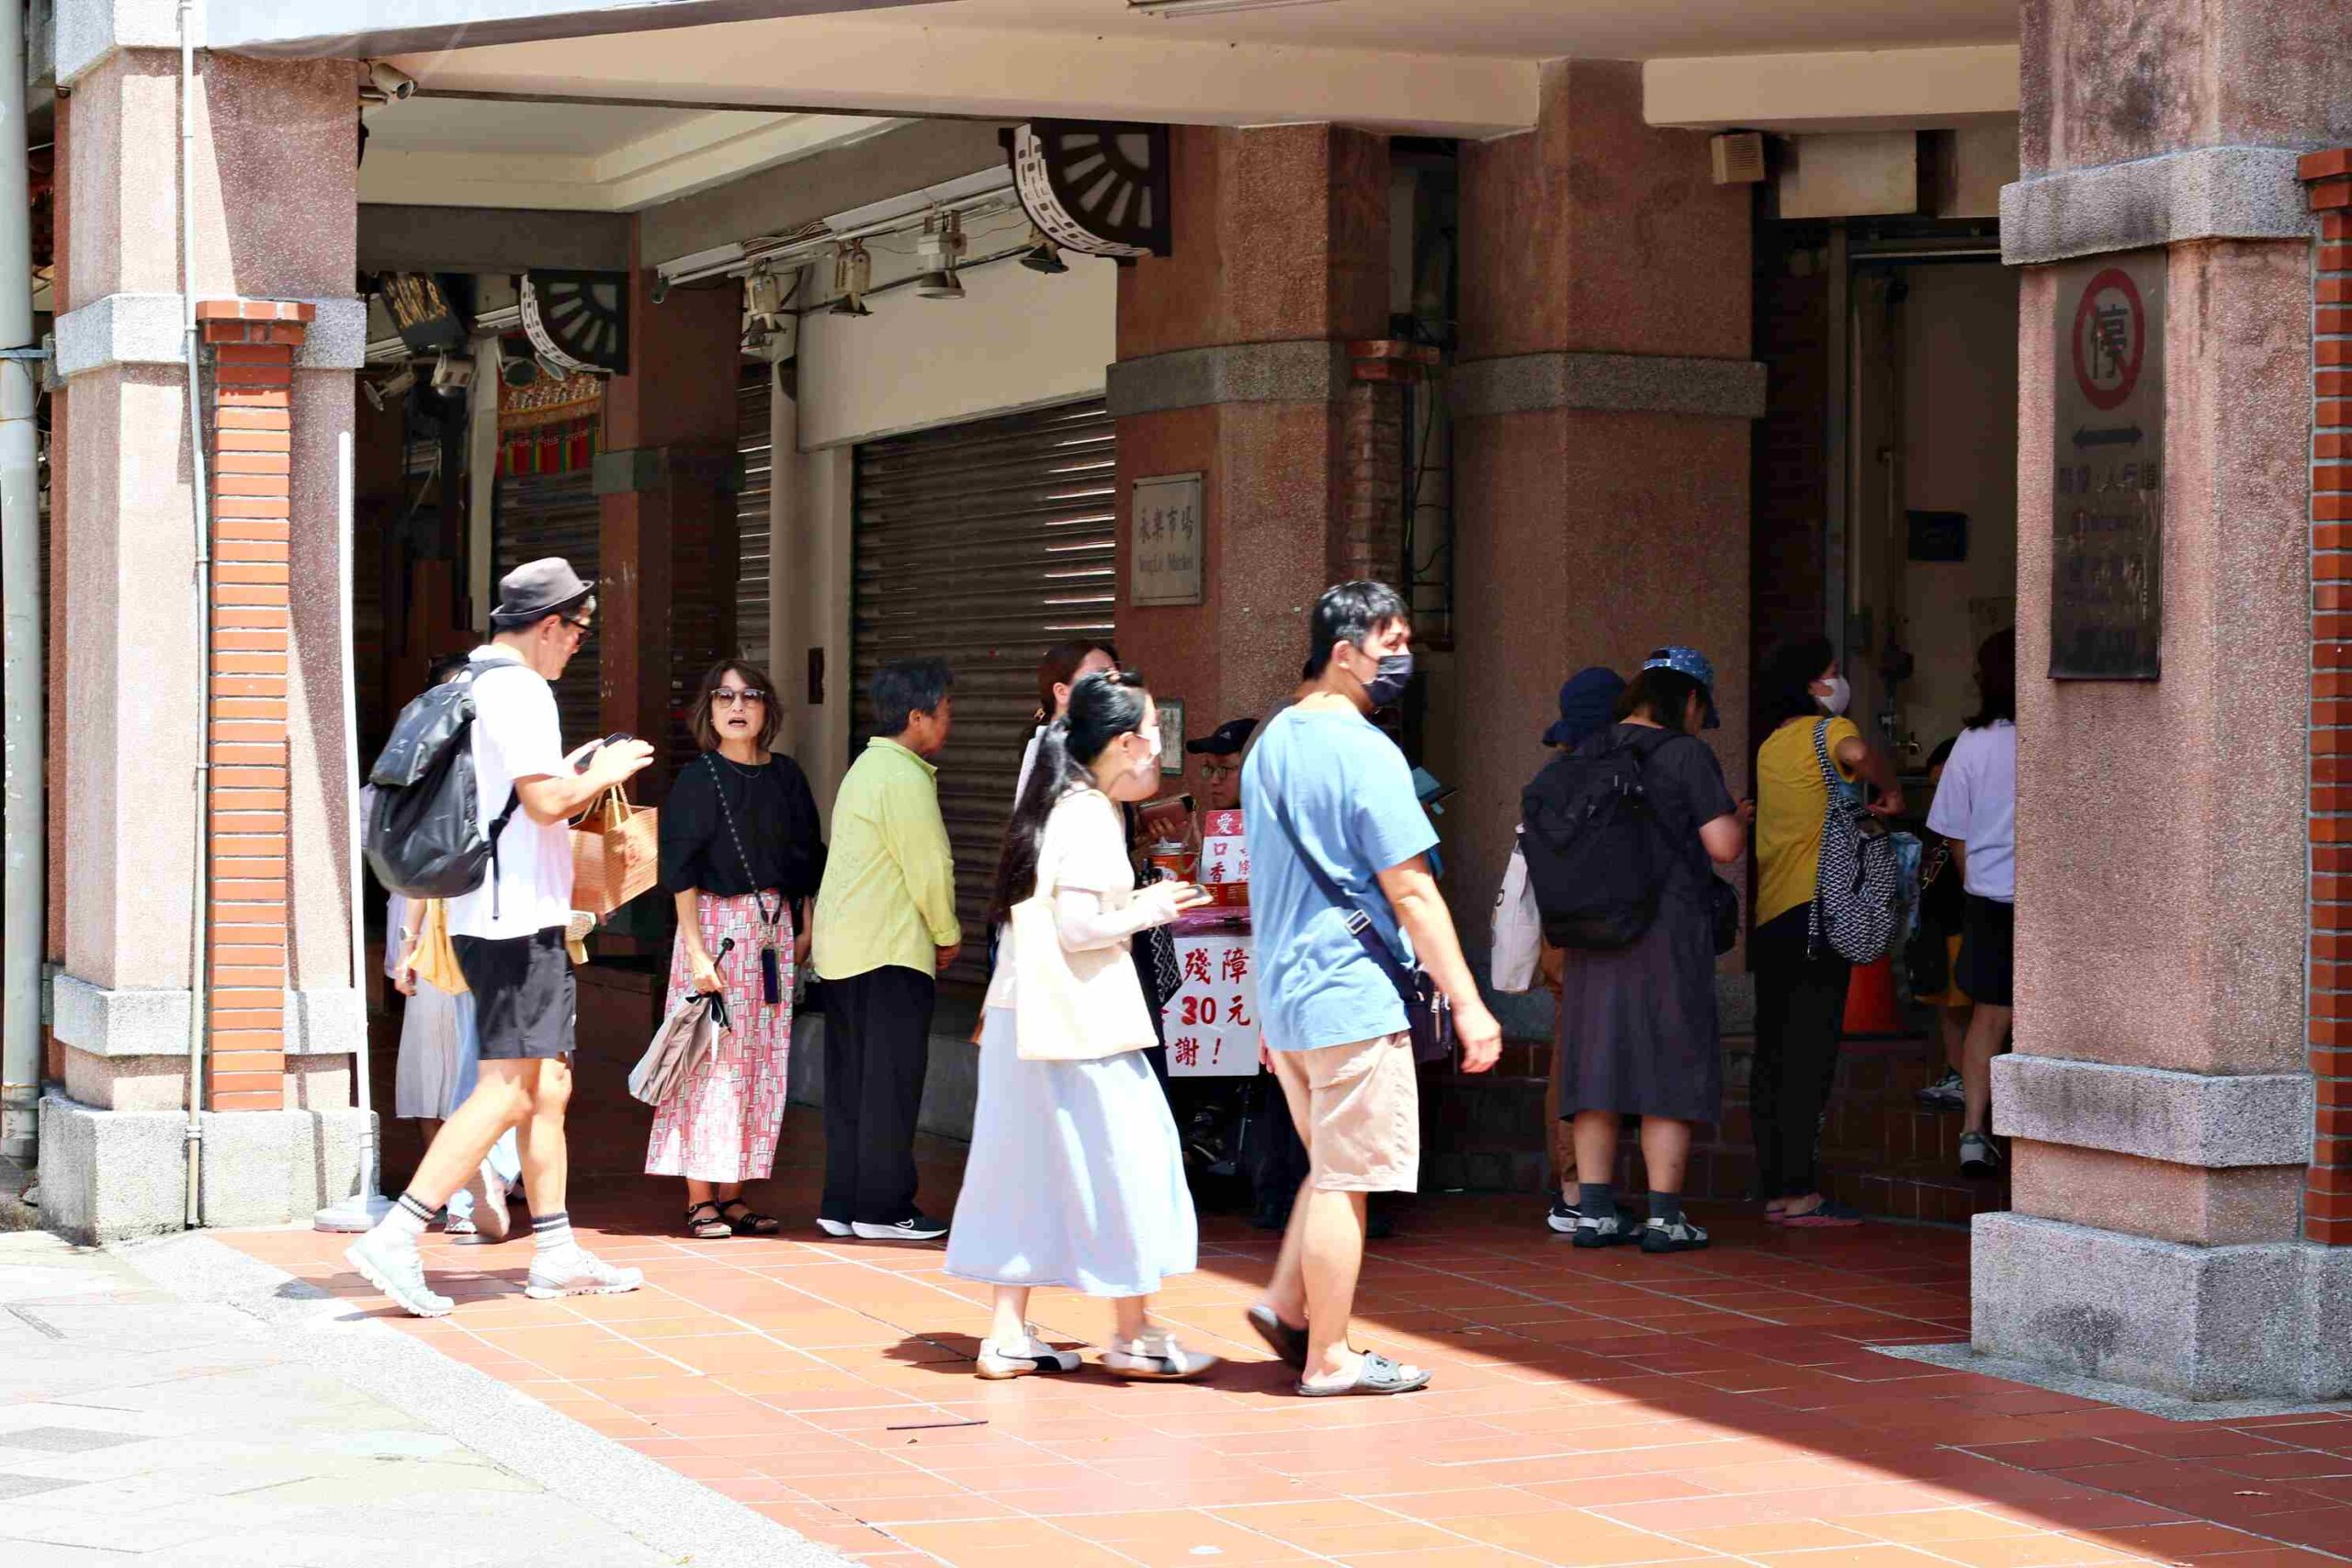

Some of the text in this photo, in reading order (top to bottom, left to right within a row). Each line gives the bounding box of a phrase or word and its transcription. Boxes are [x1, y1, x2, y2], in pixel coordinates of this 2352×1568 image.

[2090, 303, 2129, 380] 停
[1216, 813, 1243, 834] 愛
[1183, 948, 1250, 985] 殘障
[1161, 995, 1250, 1026] 30元
[1163, 1037, 1221, 1066] 謝！
